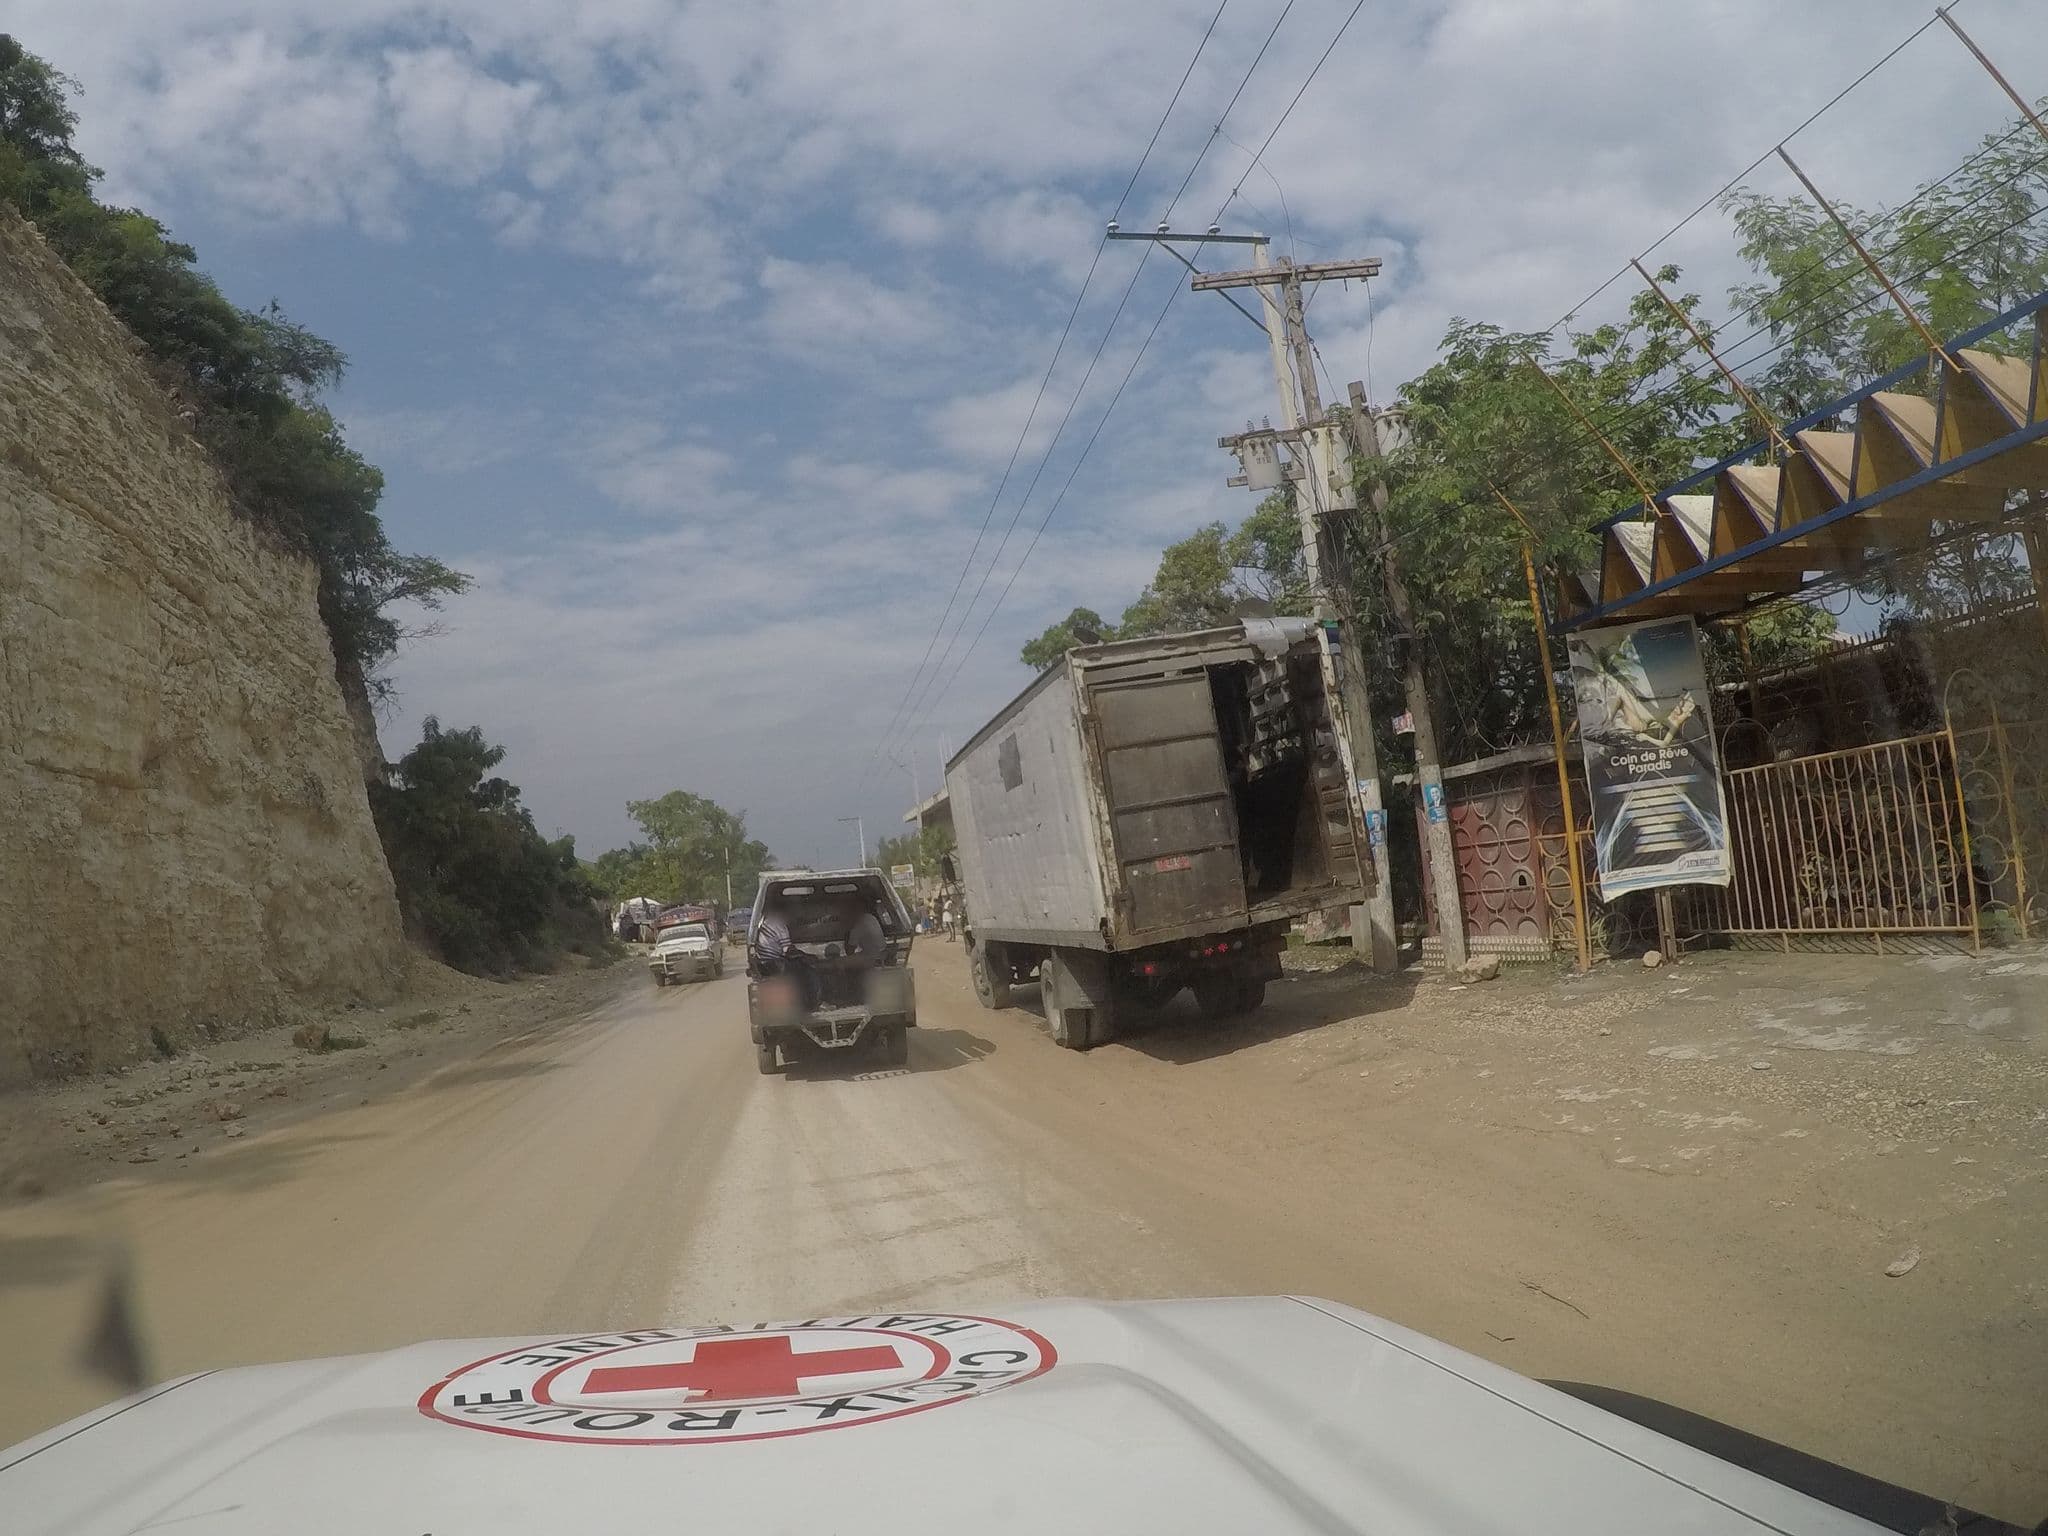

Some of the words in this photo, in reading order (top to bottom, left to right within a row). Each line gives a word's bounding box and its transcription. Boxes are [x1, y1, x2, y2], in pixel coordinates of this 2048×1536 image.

[1610, 754, 1638, 766] Coin
[1640, 751, 1657, 762] de
[1658, 747, 1689, 759] Rêve
[1628, 759, 1672, 774] Paradis
[453, 1350, 1028, 1431] CROIX-ROUGE
